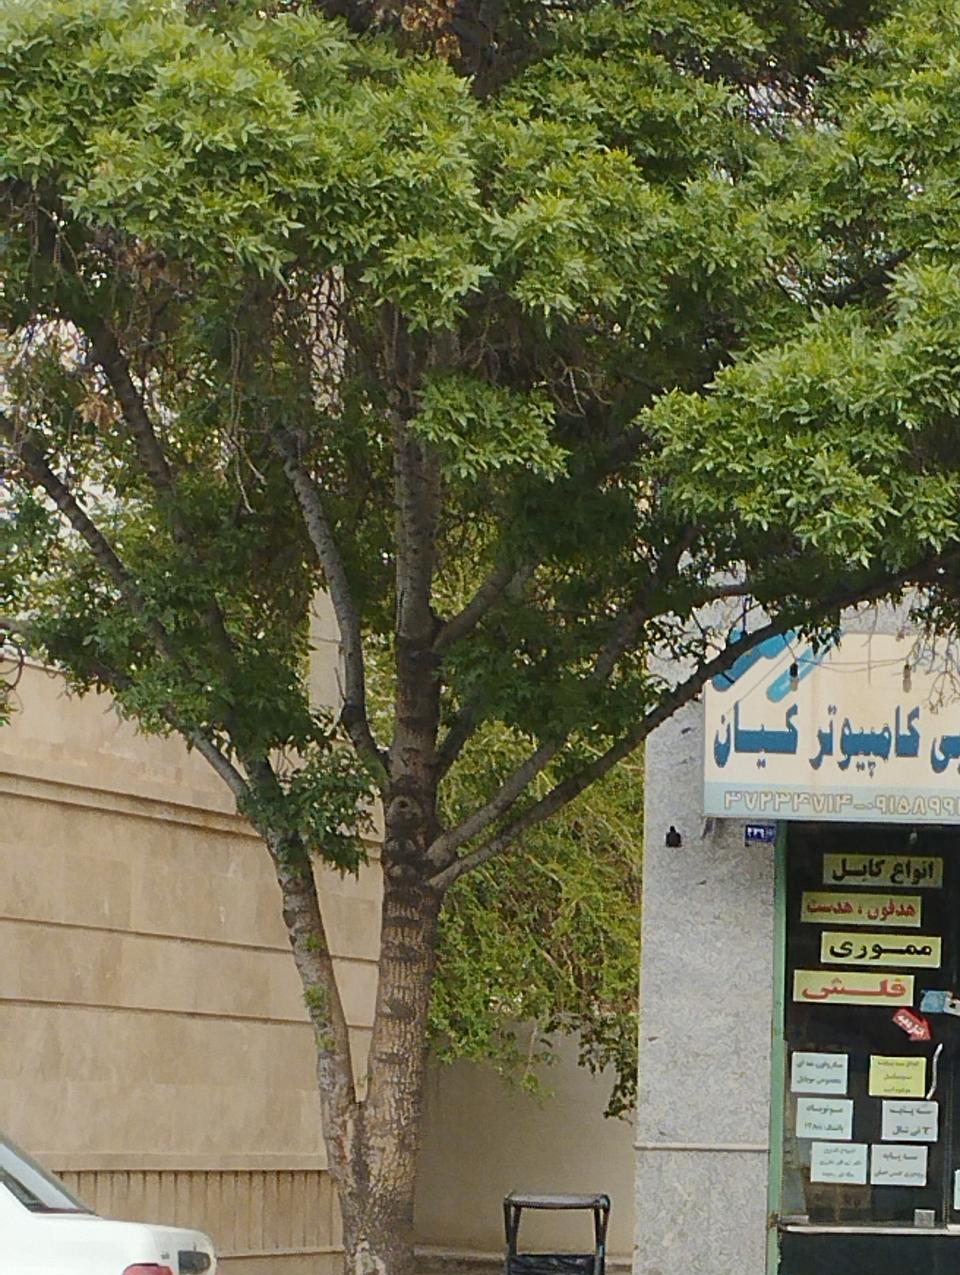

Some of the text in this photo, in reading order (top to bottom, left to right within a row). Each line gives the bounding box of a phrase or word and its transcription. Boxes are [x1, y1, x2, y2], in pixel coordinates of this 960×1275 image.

[713, 700, 798, 768] کیان
[809, 704, 920, 778] کامپیوتر
[832, 857, 934, 885] انواع کابل
[867, 898, 916, 921] هدفون
[829, 941, 933, 960] مموری
[801, 977, 906, 1000] فلش
